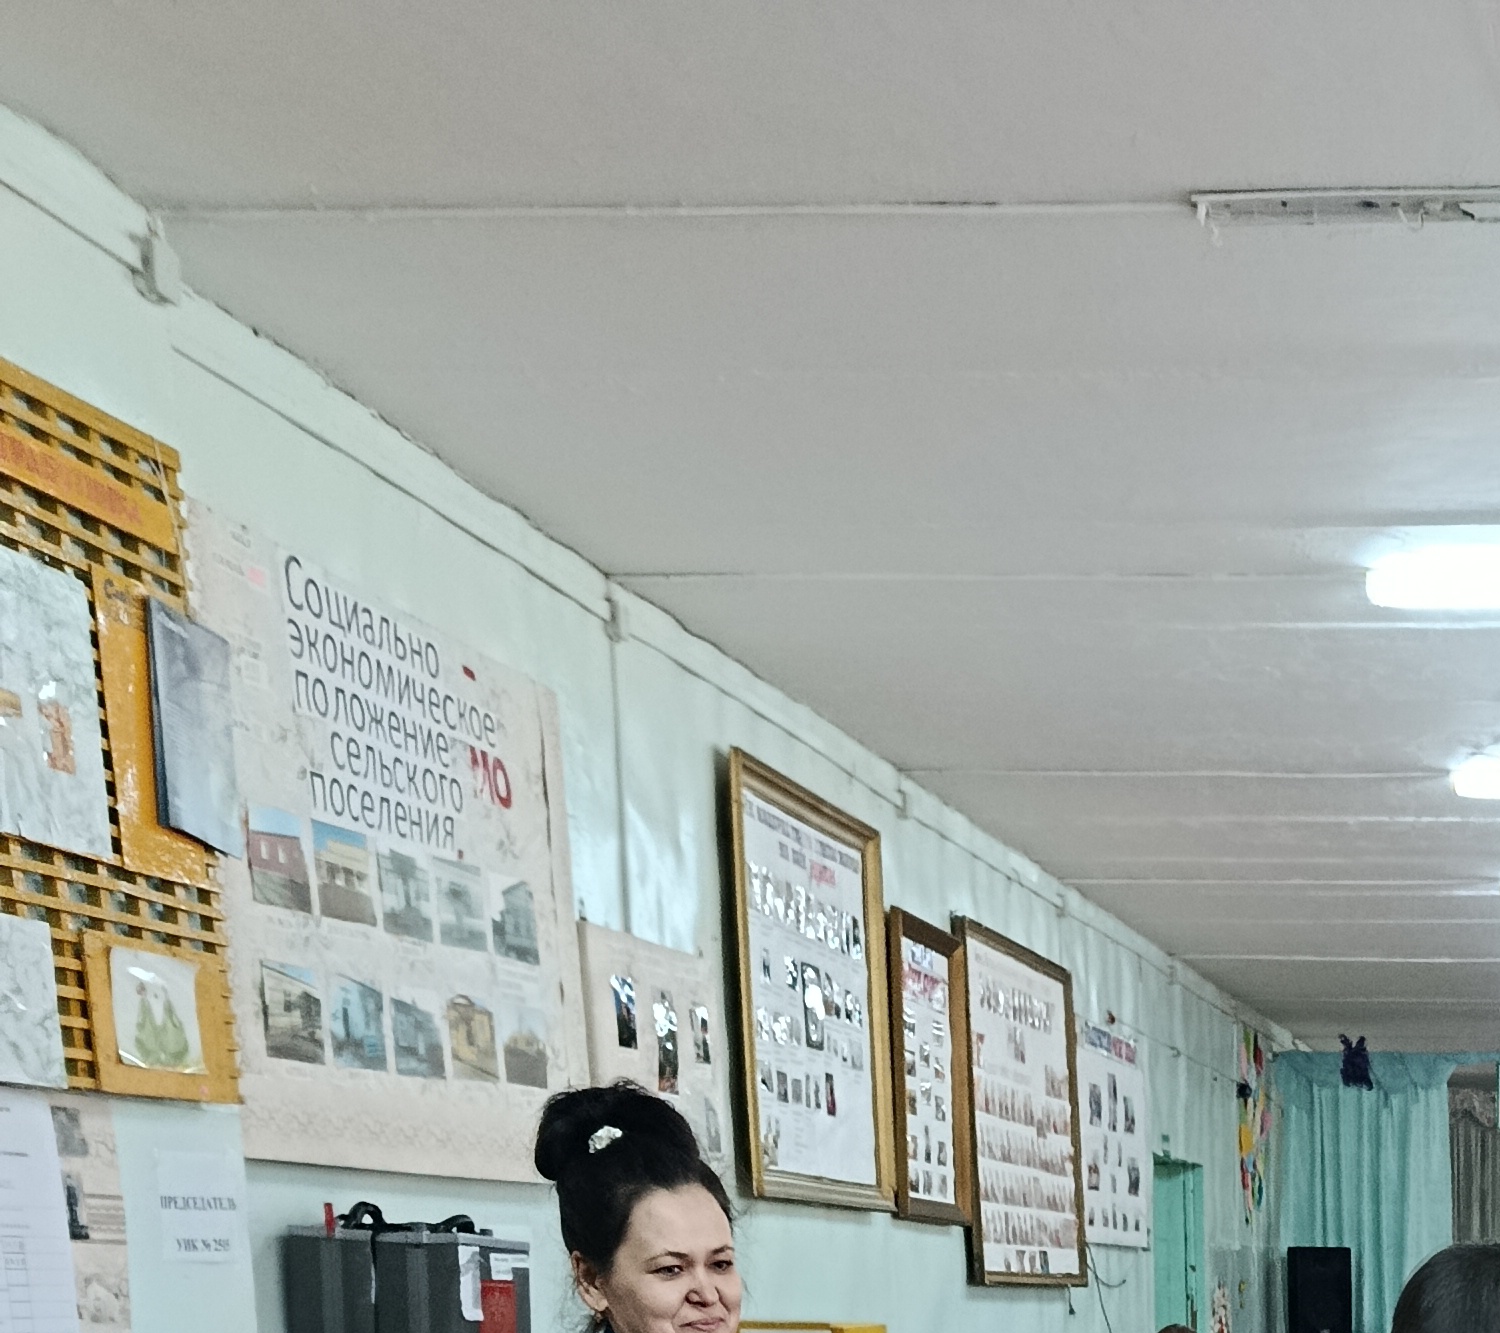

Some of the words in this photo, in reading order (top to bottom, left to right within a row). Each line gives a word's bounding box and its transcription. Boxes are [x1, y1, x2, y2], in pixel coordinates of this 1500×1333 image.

[284, 555, 440, 679] Социально
[286, 618, 497, 748] экономическое
[294, 669, 450, 768] положение
[309, 770, 456, 849] поселения
[330, 731, 463, 814] сельского
[160, 1196, 237, 1211] ПРЕДСЕДАТЕЛЬ
[176, 1238, 199, 1252] УИК
